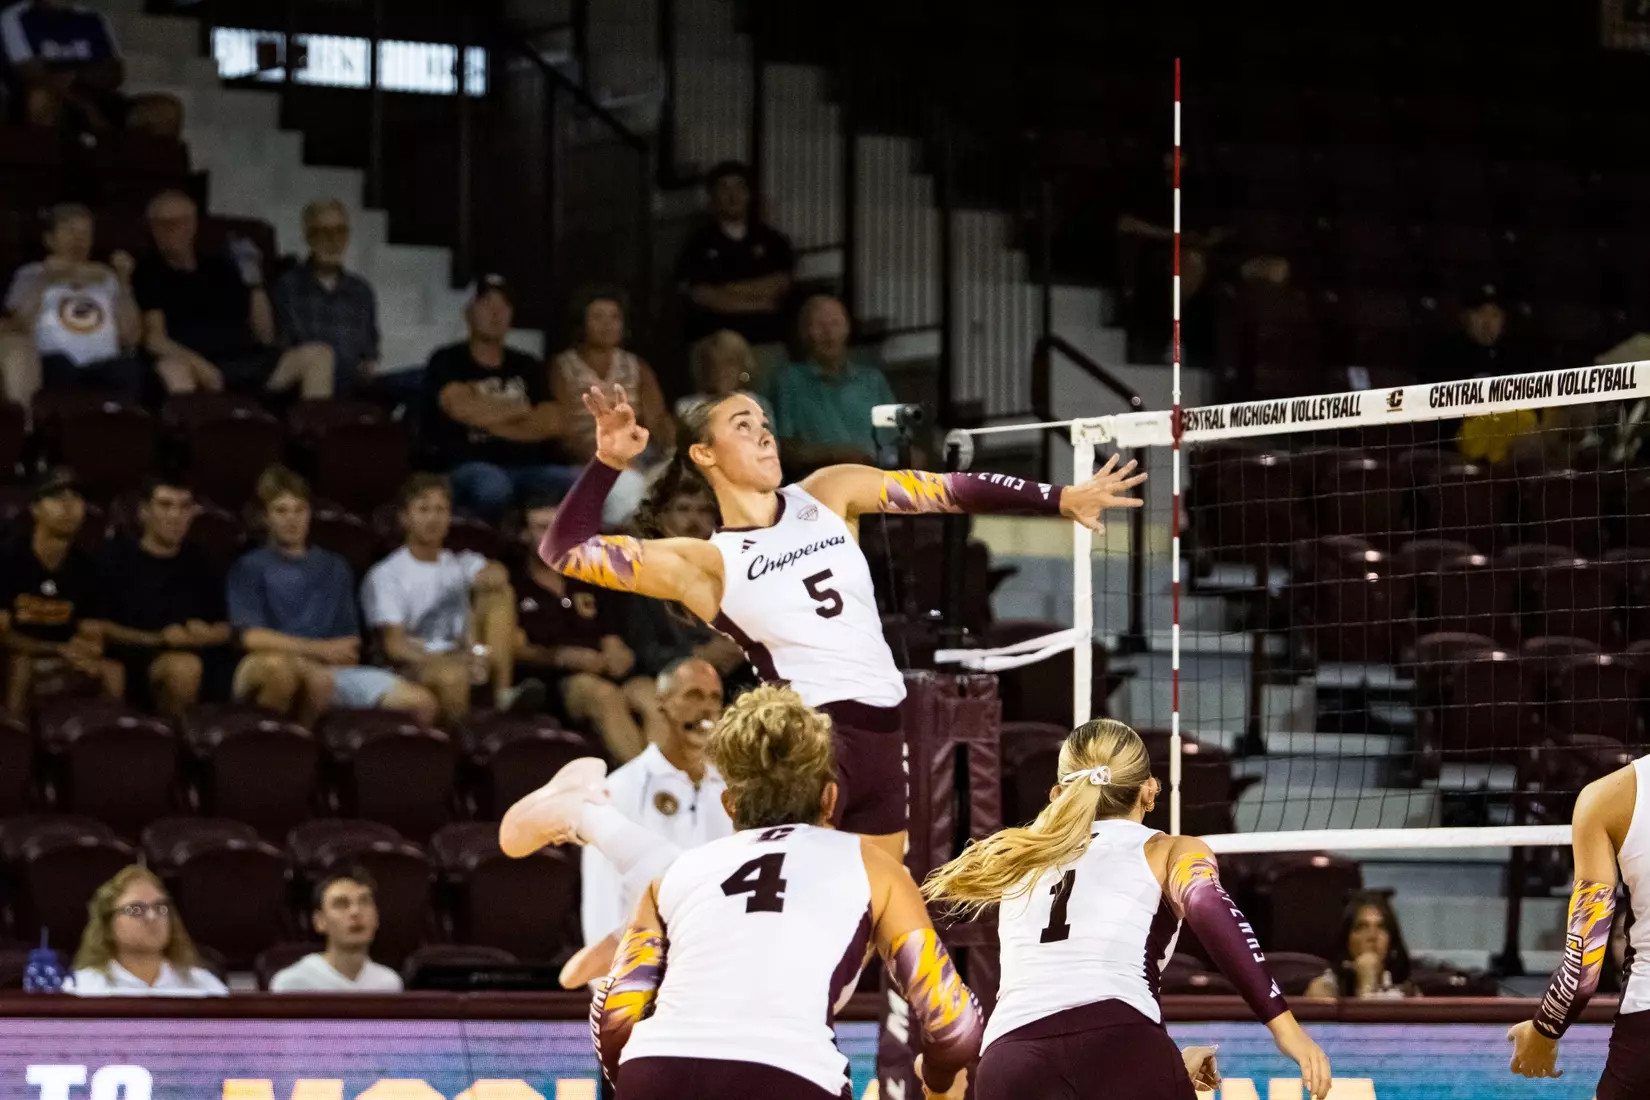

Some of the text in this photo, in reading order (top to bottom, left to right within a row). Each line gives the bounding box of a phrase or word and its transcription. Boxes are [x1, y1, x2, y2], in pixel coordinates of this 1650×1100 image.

[1229, 401, 1288, 428] MICHIGAN
[1291, 394, 1362, 423] VOLLEYBALL
[1429, 365, 1637, 409] CENTRAL MICHIGAN VOLLEYBALL
[747, 535, 846, 581] Chippewas
[802, 568, 844, 619] 5
[720, 852, 788, 914] 4
[1039, 869, 1077, 944] 1
